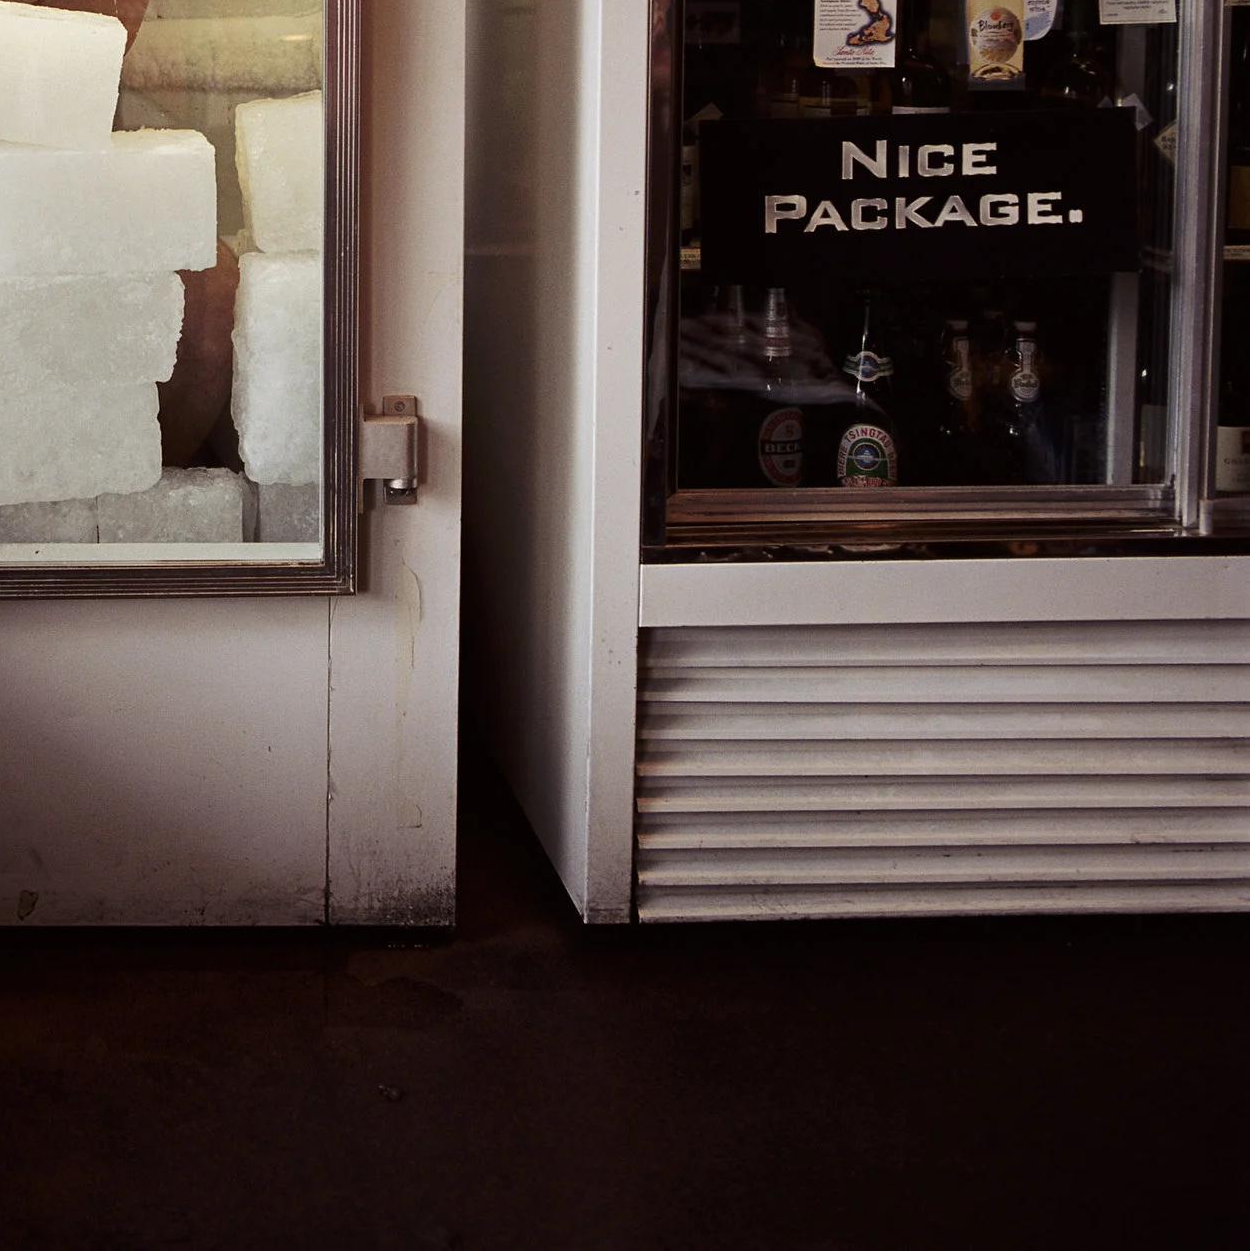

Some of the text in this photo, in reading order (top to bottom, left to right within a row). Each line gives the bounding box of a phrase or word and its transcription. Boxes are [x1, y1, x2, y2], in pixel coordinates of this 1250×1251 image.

[842, 140, 998, 179] NICE
[764, 192, 1083, 234] PACKAGE.
[845, 427, 891, 450] TSINGTAO
